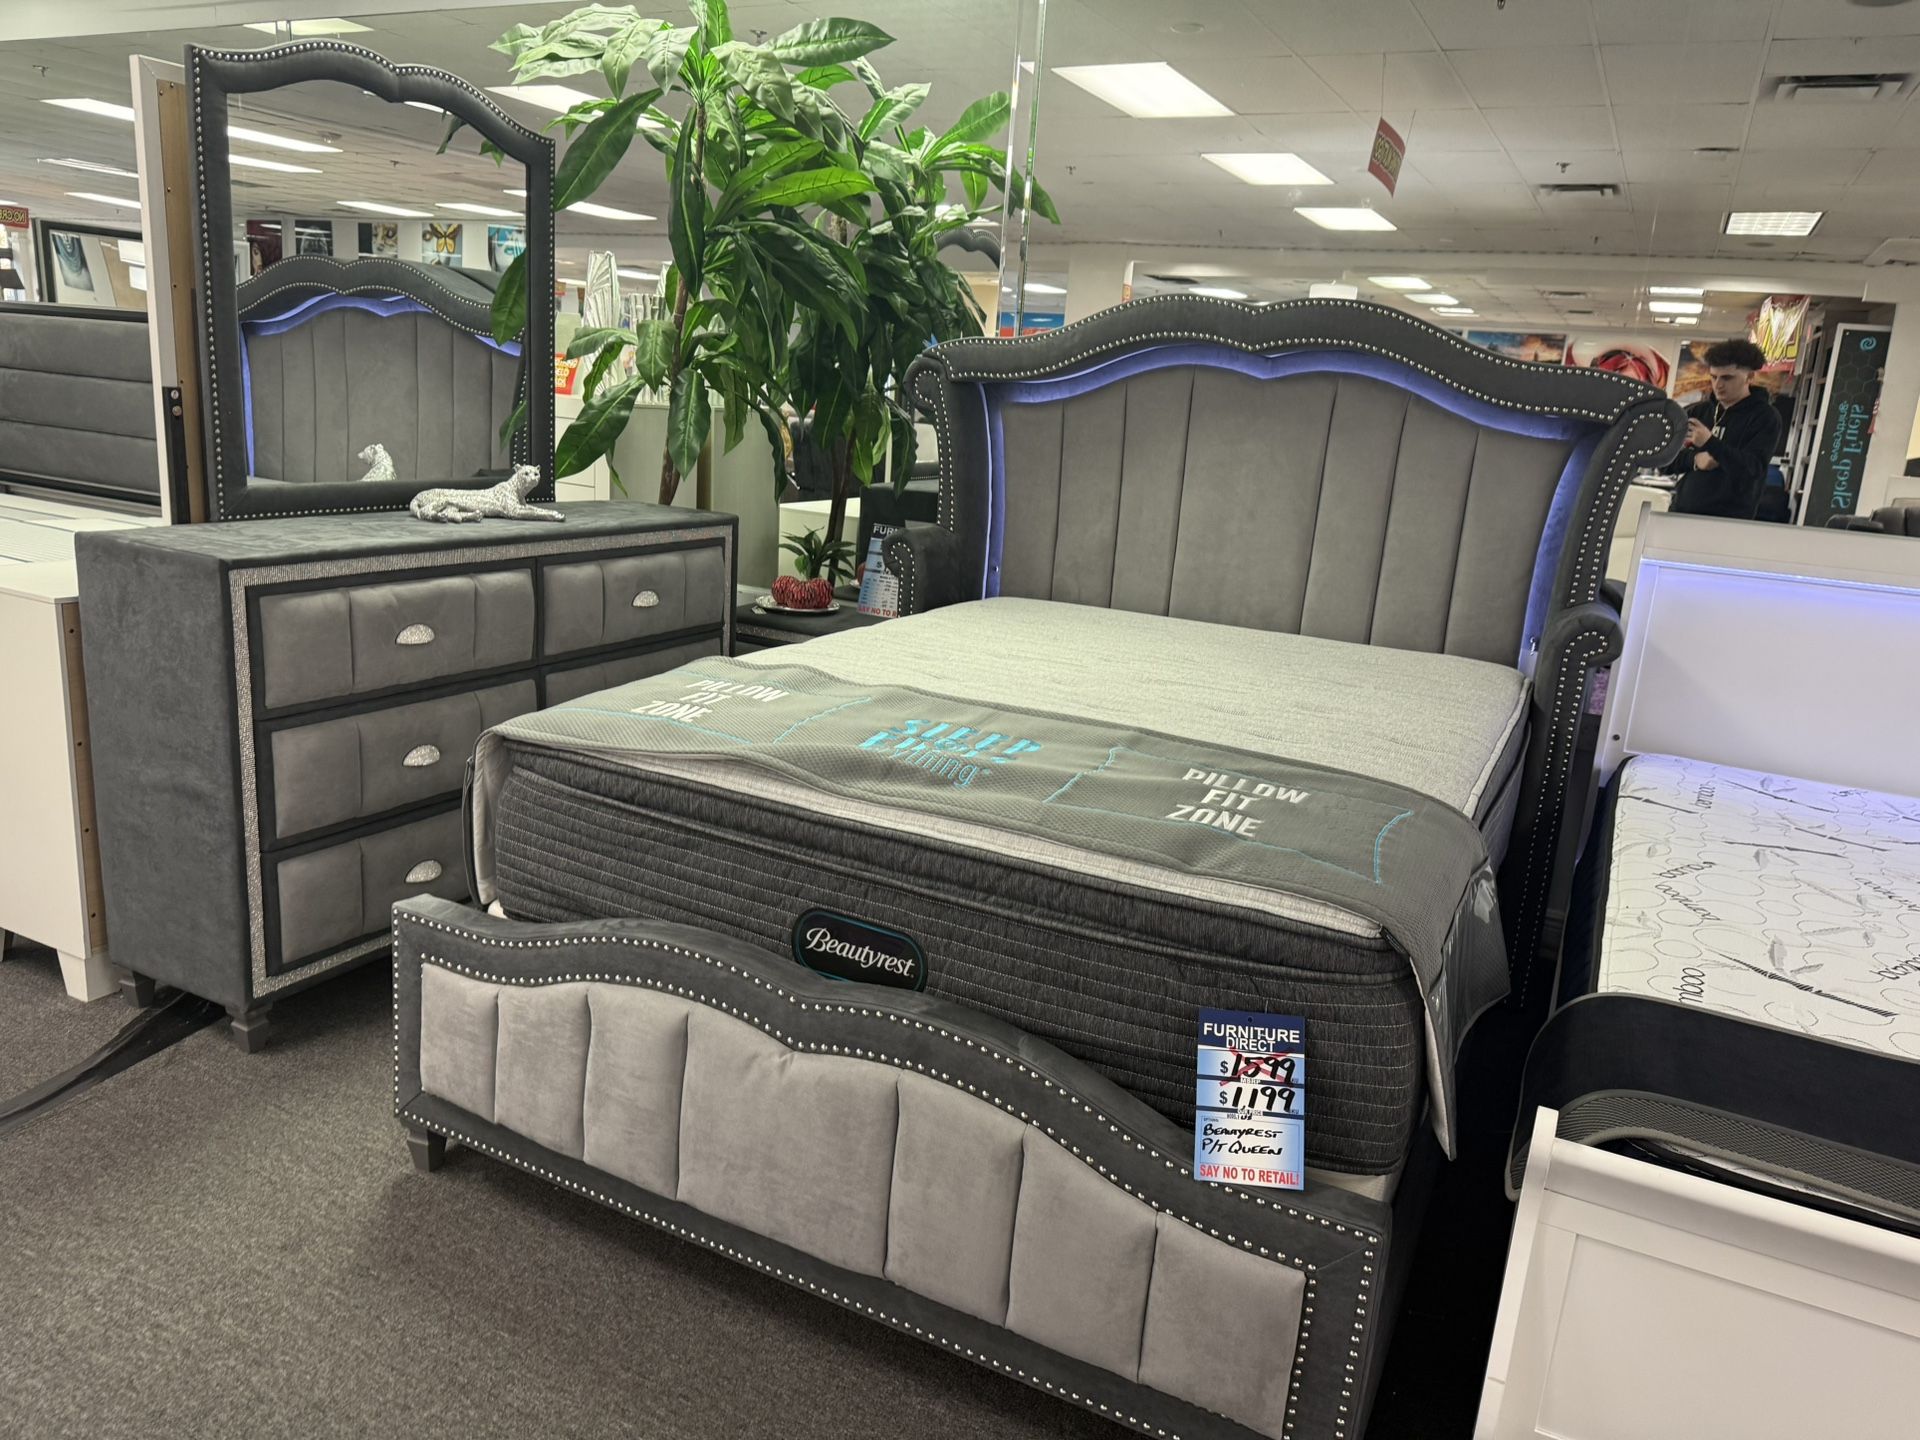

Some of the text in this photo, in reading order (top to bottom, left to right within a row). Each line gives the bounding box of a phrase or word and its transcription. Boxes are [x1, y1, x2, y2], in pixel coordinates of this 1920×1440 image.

[685, 679, 790, 703] PILLOW
[631, 700, 713, 723] ZONE
[1181, 768, 1310, 804] PILLOW
[1200, 788, 1261, 811] FIT
[1164, 803, 1265, 838] ZONE
[805, 927, 916, 977] Beautyrest
[1203, 1022, 1300, 1044] FURNITURE
[1226, 1036, 1276, 1052] DIRECT
[1228, 1140, 1283, 1155] QUEEN
[1200, 1164, 1299, 1185] SAY NO TO RETAIL!
